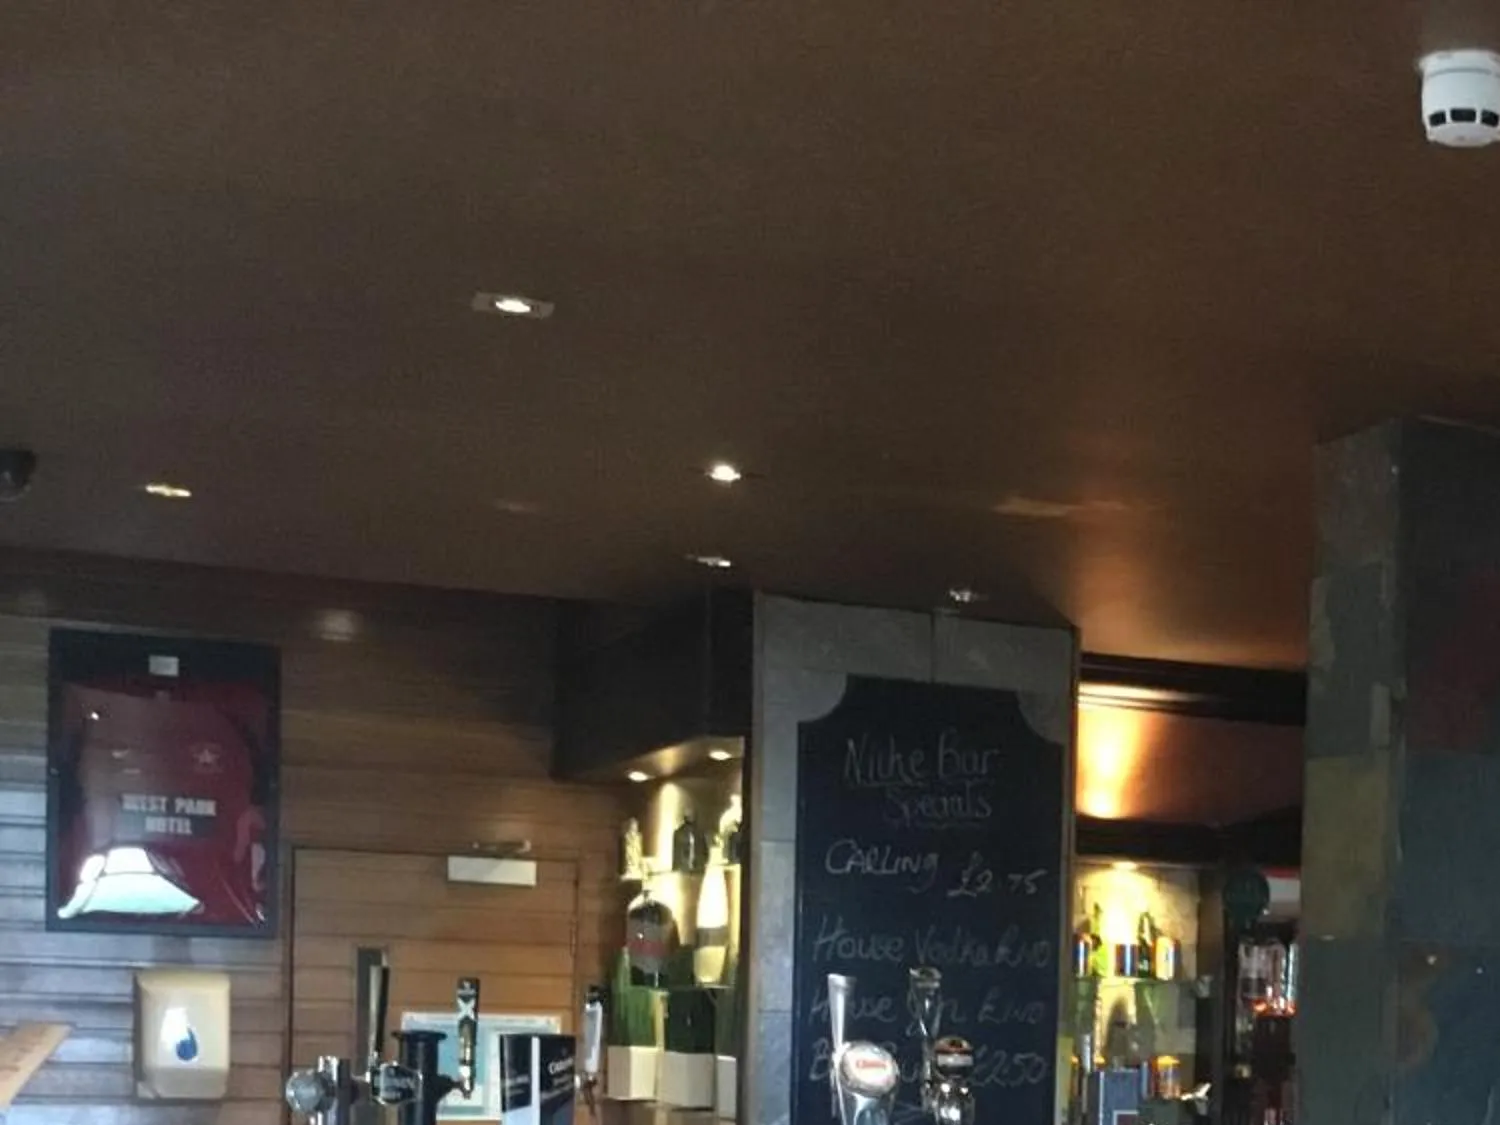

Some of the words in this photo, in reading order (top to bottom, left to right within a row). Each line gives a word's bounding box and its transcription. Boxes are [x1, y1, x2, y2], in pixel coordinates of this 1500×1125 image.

[937, 727, 1001, 779] Bar
[144, 816, 192, 835] HOTEL
[175, 796, 218, 816] PARK
[812, 913, 904, 961] House
[808, 986, 897, 1026] Huse
